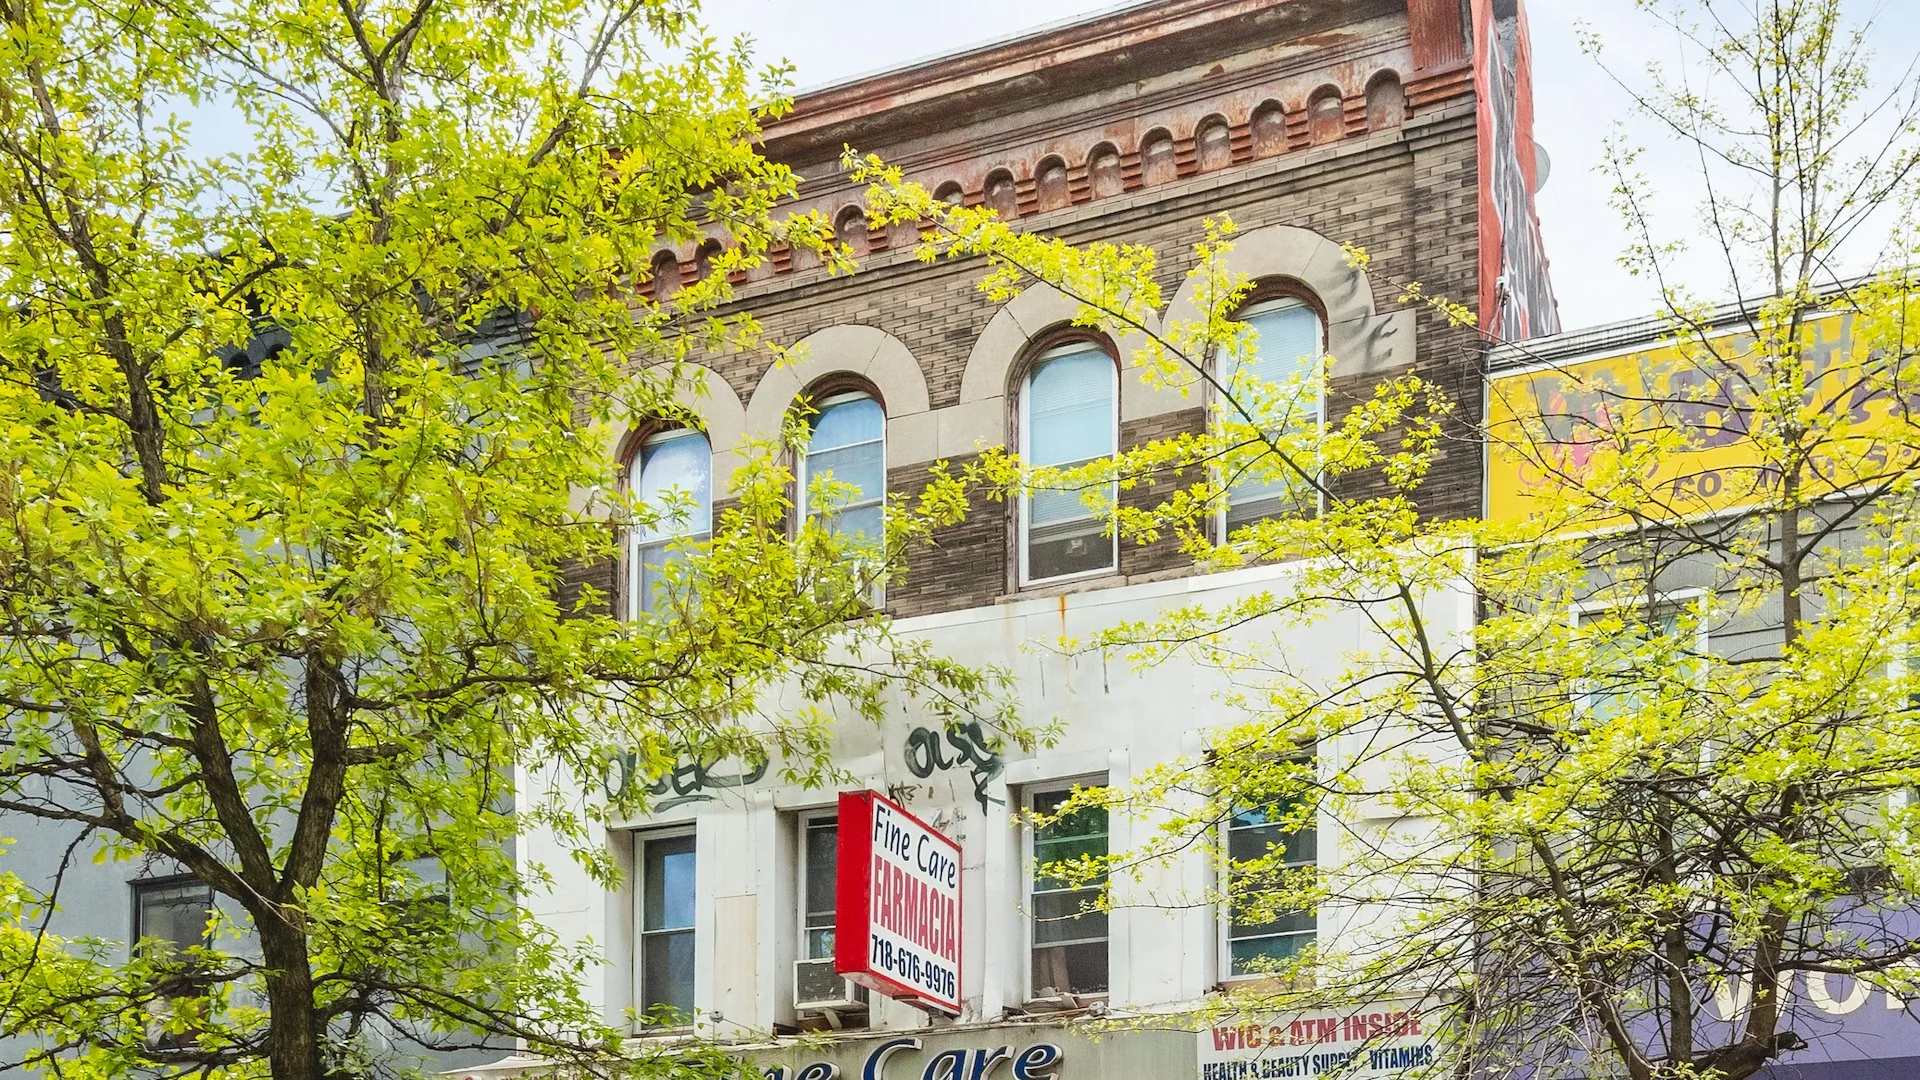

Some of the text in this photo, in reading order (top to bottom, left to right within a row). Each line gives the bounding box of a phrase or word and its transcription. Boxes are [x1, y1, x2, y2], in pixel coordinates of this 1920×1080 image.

[874, 804, 956, 889] Fine Care
[873, 854, 956, 963] FARMACIA
[872, 934, 955, 999] 718-676-9976
[862, 1037, 1062, 1080] Care
[1212, 1010, 1422, 1051] WIC & ATM INSIDE
